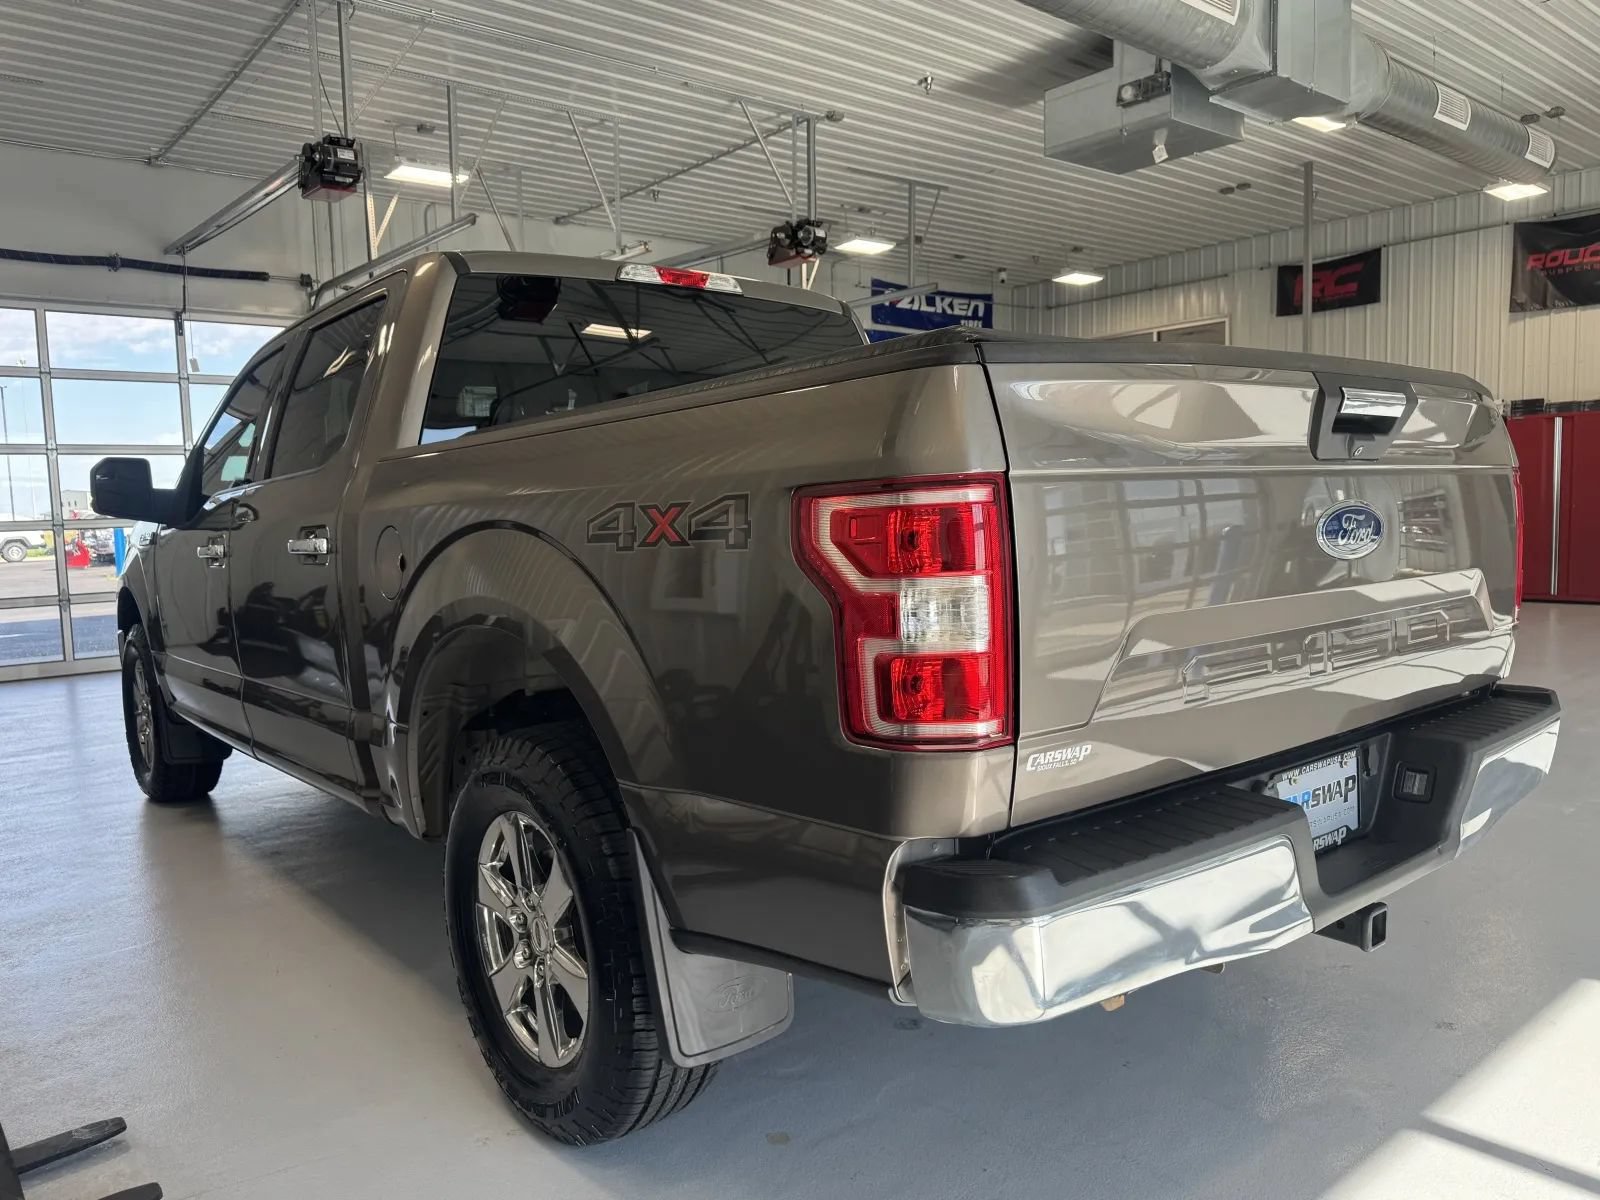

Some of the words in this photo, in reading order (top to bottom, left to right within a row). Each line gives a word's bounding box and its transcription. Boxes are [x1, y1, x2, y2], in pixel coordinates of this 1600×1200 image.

[884, 288, 984, 317] ALKEN
[1337, 513, 1379, 546] Ford
[1182, 610, 1450, 704] F-150
[1026, 744, 1092, 771] CARSWAP
[1037, 764, 1052, 772] SIOUX
[1281, 750, 1357, 781] WWW.CARSWAPUSA.COM
[1283, 774, 1357, 809] ARSWAP
[1313, 826, 1347, 851] RSWAP
